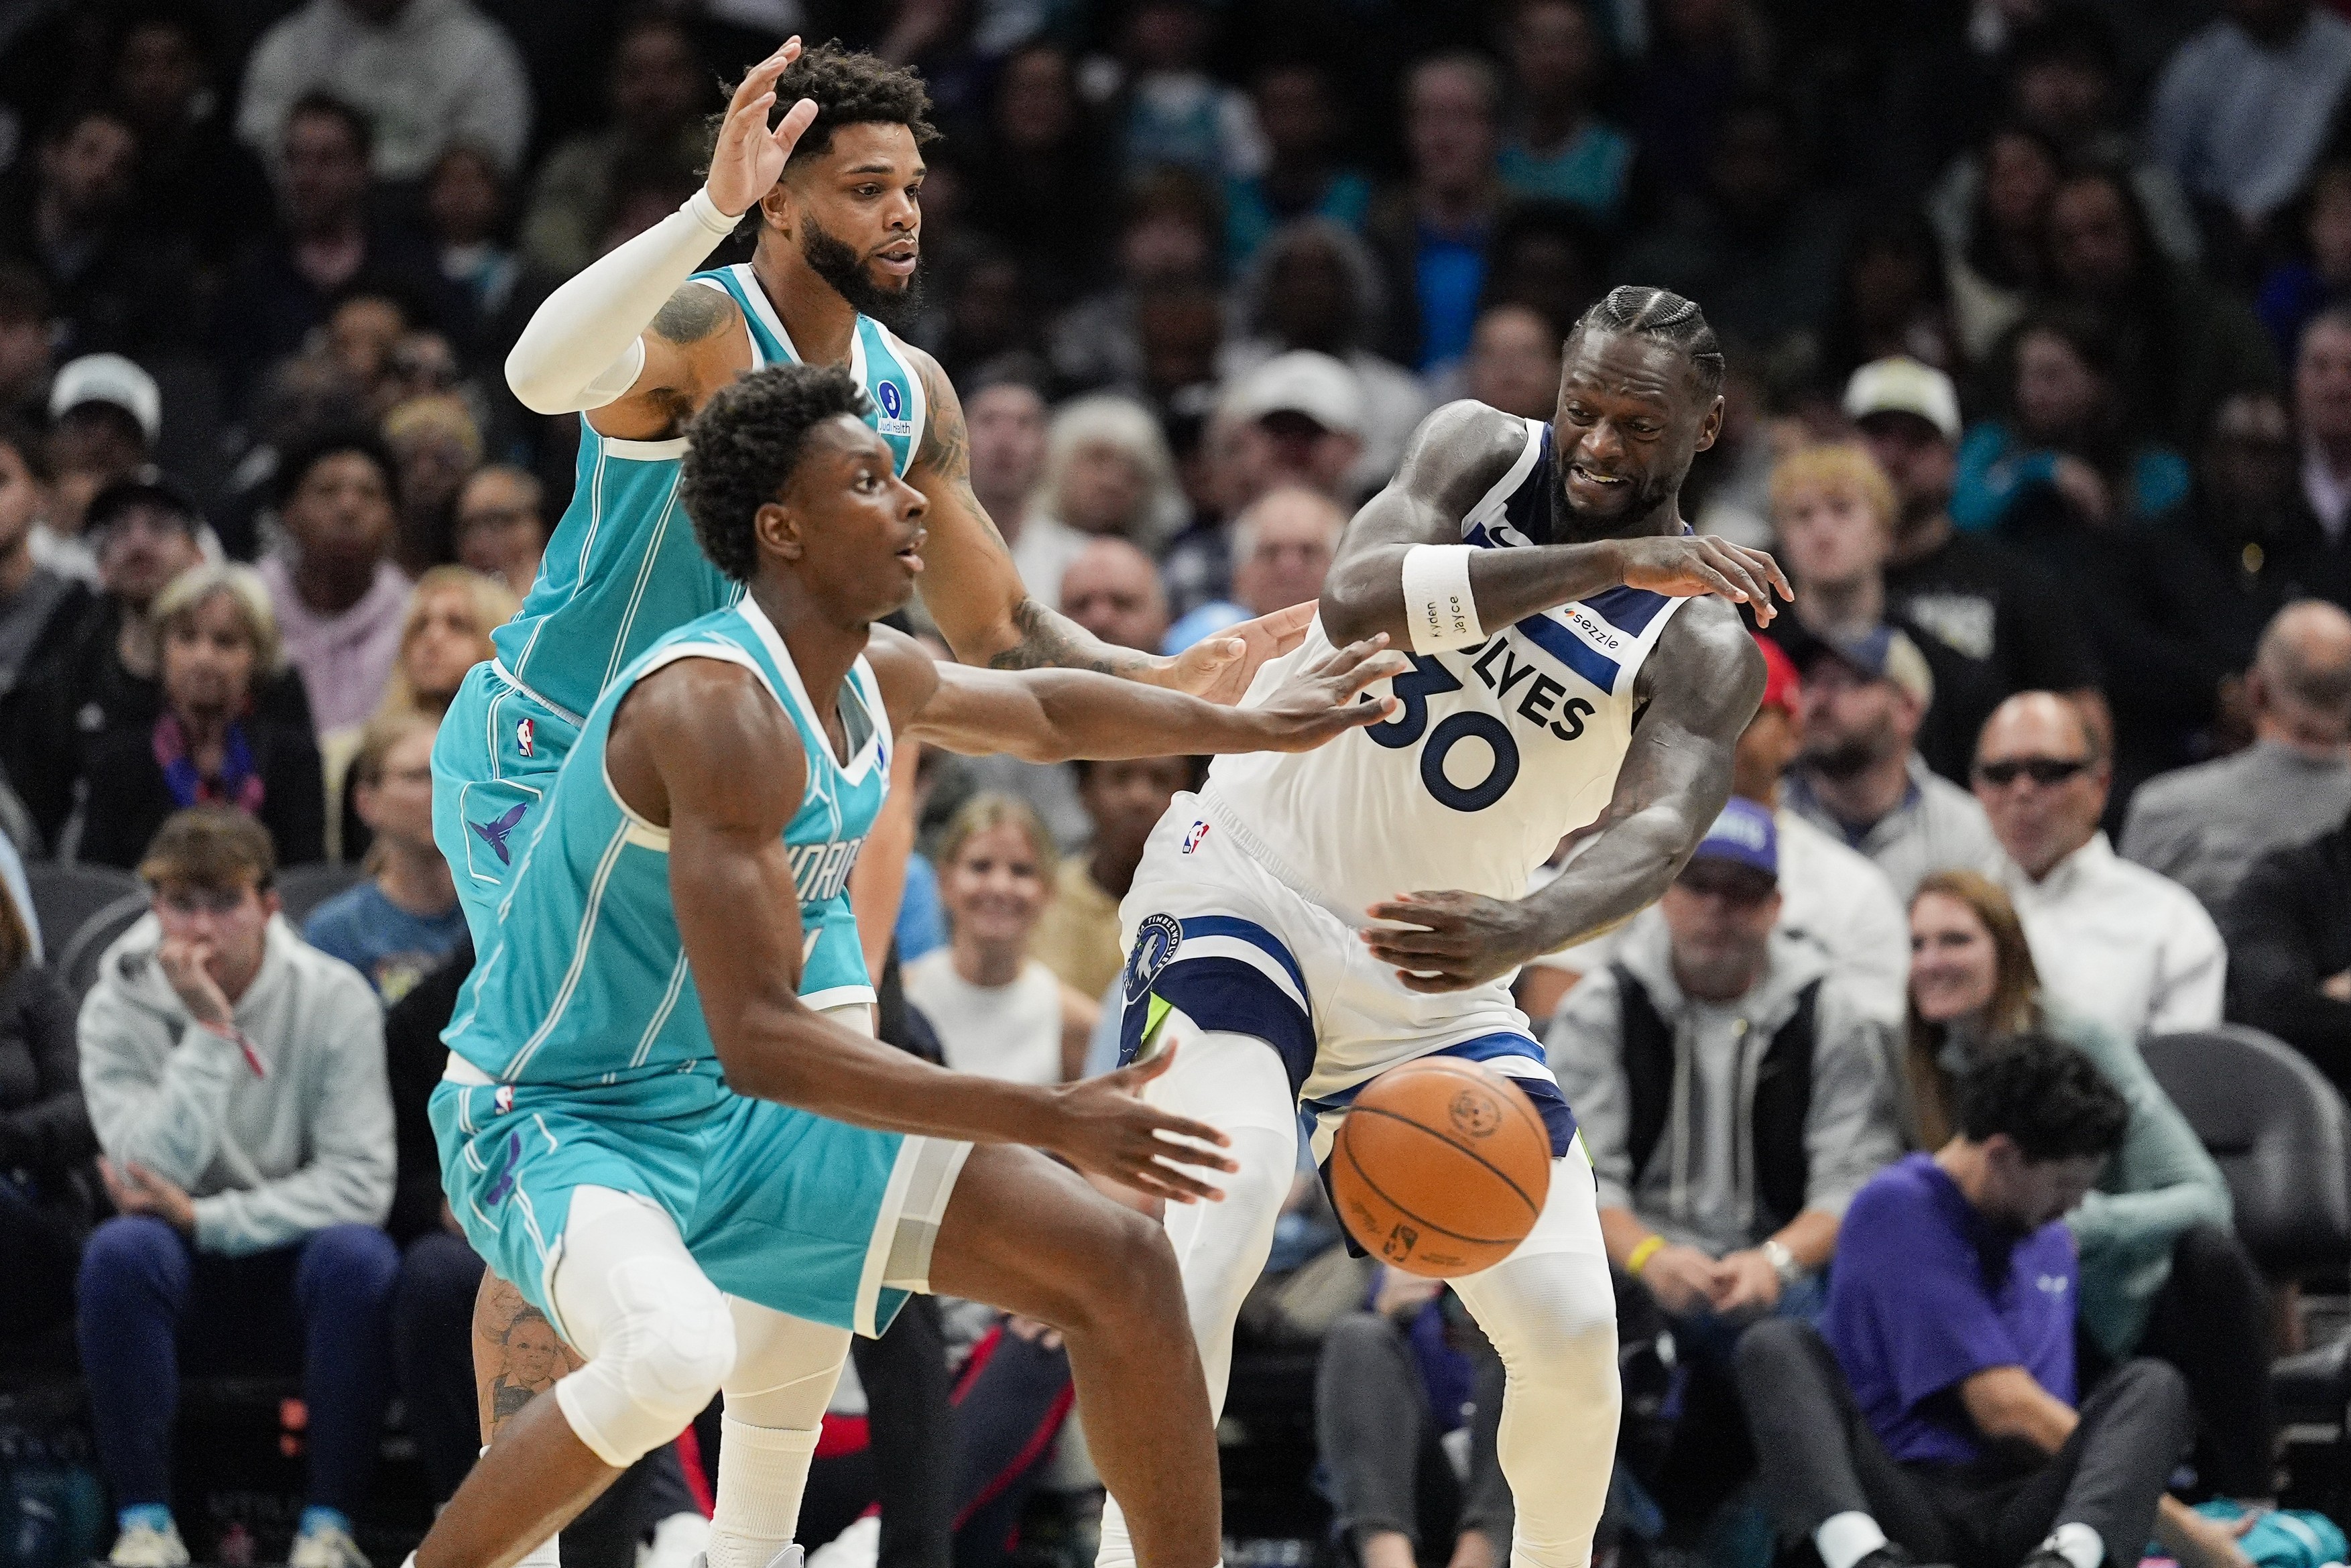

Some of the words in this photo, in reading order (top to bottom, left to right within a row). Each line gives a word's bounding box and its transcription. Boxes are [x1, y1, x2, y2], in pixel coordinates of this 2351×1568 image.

[880, 421, 892, 431] Judi
[1427, 601, 1443, 638] Kyden
[1450, 595, 1466, 634] Jayce
[1573, 611, 1619, 650] sezzle
[1457, 636, 1595, 741] LVES
[1360, 651, 1519, 811] 30
